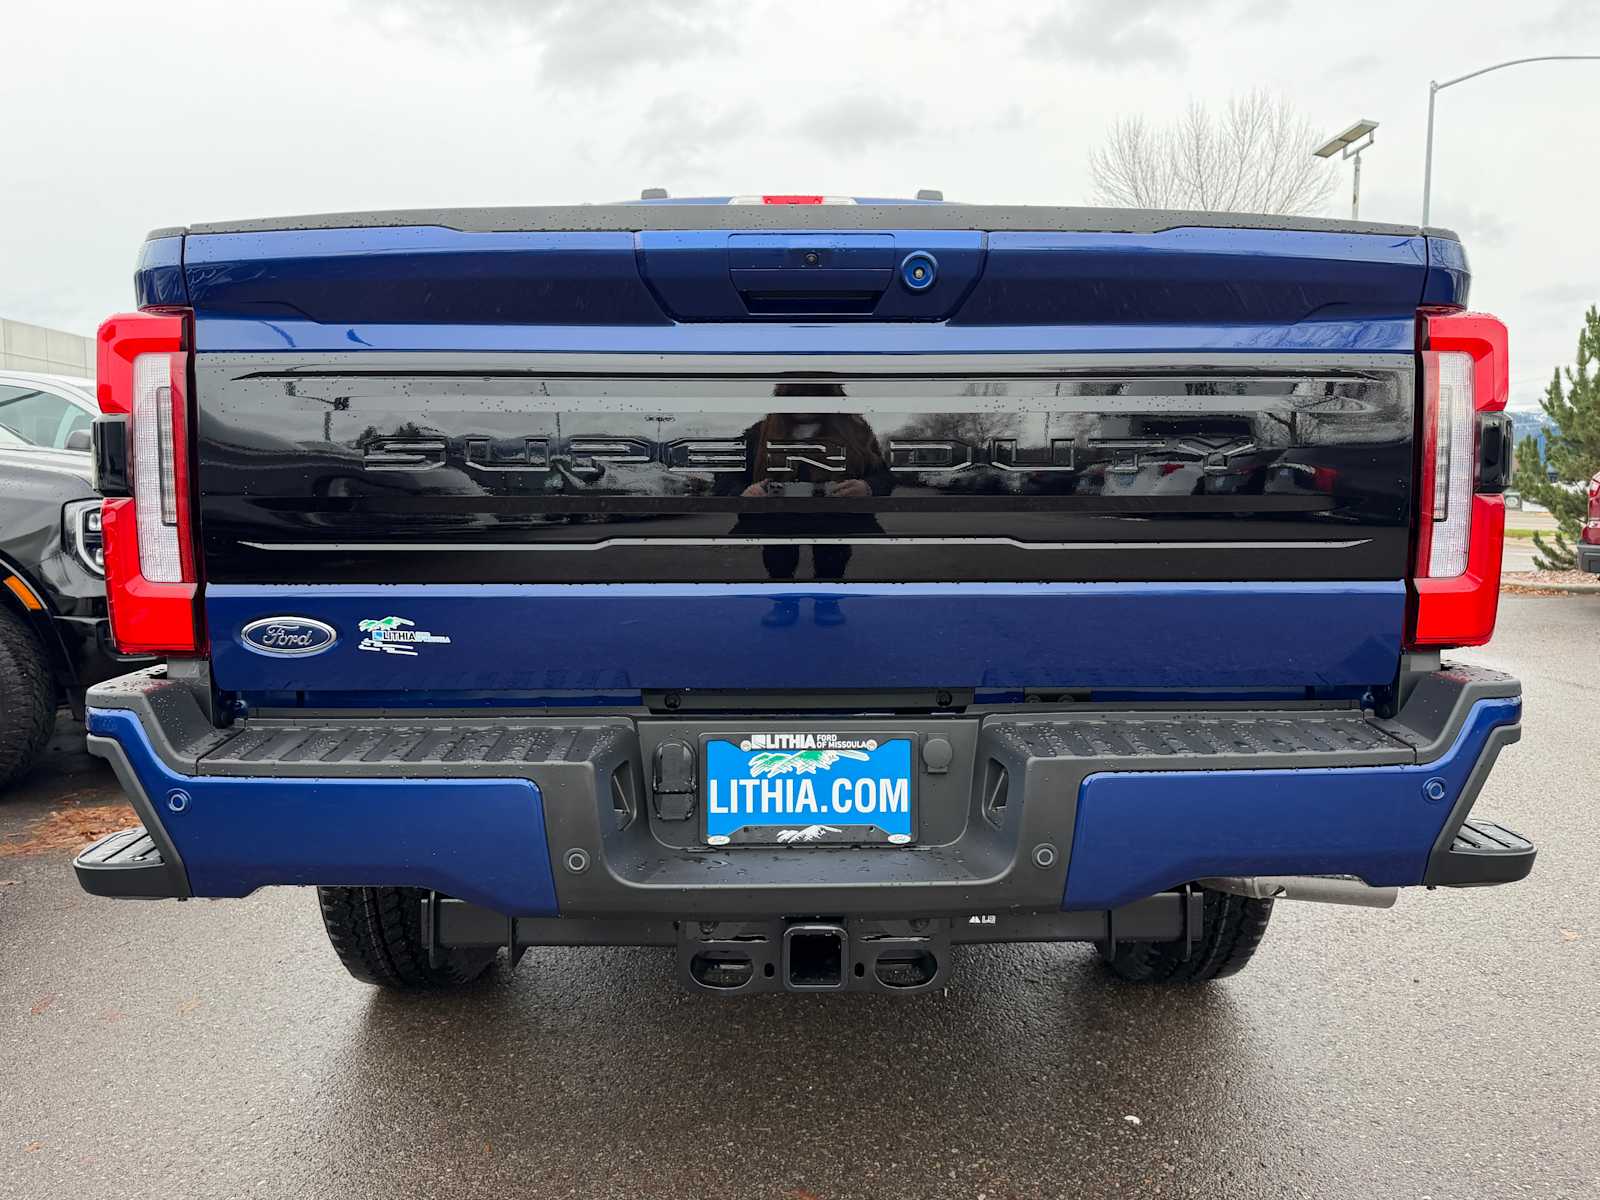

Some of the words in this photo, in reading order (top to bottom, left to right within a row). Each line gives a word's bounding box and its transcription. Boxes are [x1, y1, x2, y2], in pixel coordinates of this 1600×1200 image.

[363, 435, 847, 472] SUPER
[889, 435, 1256, 472] DUTY
[262, 623, 314, 647] Ford
[383, 631, 416, 641] LITHIA
[766, 734, 817, 750] LITHIA
[816, 734, 838, 742] FORD
[816, 741, 828, 749] OF
[828, 740, 867, 749] MISSOULA
[709, 777, 909, 814] LITHIA.COM
